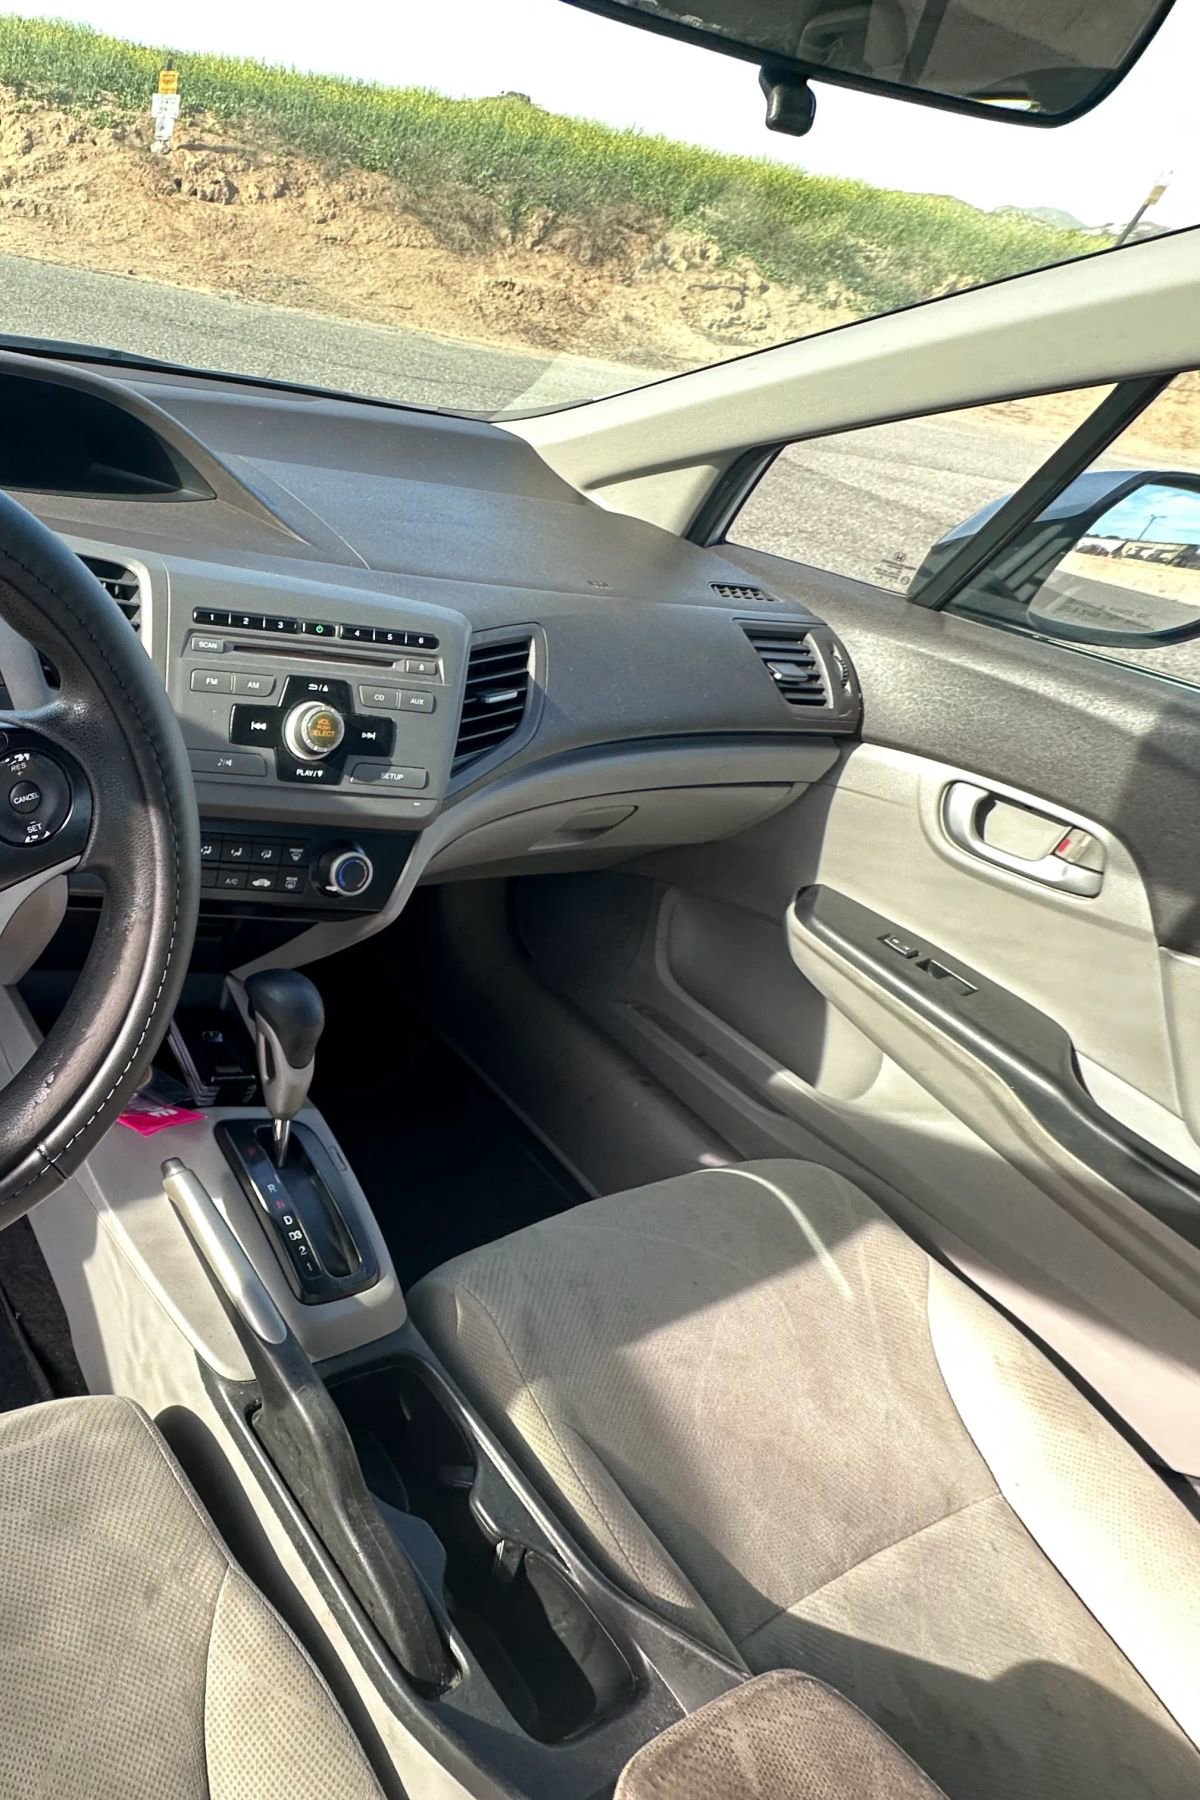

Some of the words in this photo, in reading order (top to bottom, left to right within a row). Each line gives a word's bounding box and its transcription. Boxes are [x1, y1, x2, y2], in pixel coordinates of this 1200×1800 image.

[242, 617, 249, 625] 2
[277, 621, 284, 629] 3
[387, 633, 393, 641] 5
[198, 641, 218, 650] SCAN
[206, 677, 218, 685] FM
[247, 681, 260, 689] AM
[374, 694, 384, 702] CD
[410, 697, 424, 706] AUX
[10, 762, 27, 772] RES
[381, 772, 404, 781] SETUP
[13, 792, 39, 804] CANCEL
[27, 823, 42, 833] SET
[267, 1184, 277, 1193] R
[283, 1215, 293, 1226] D
[298, 1246, 308, 1256] 2
[306, 1263, 313, 1271] 1
